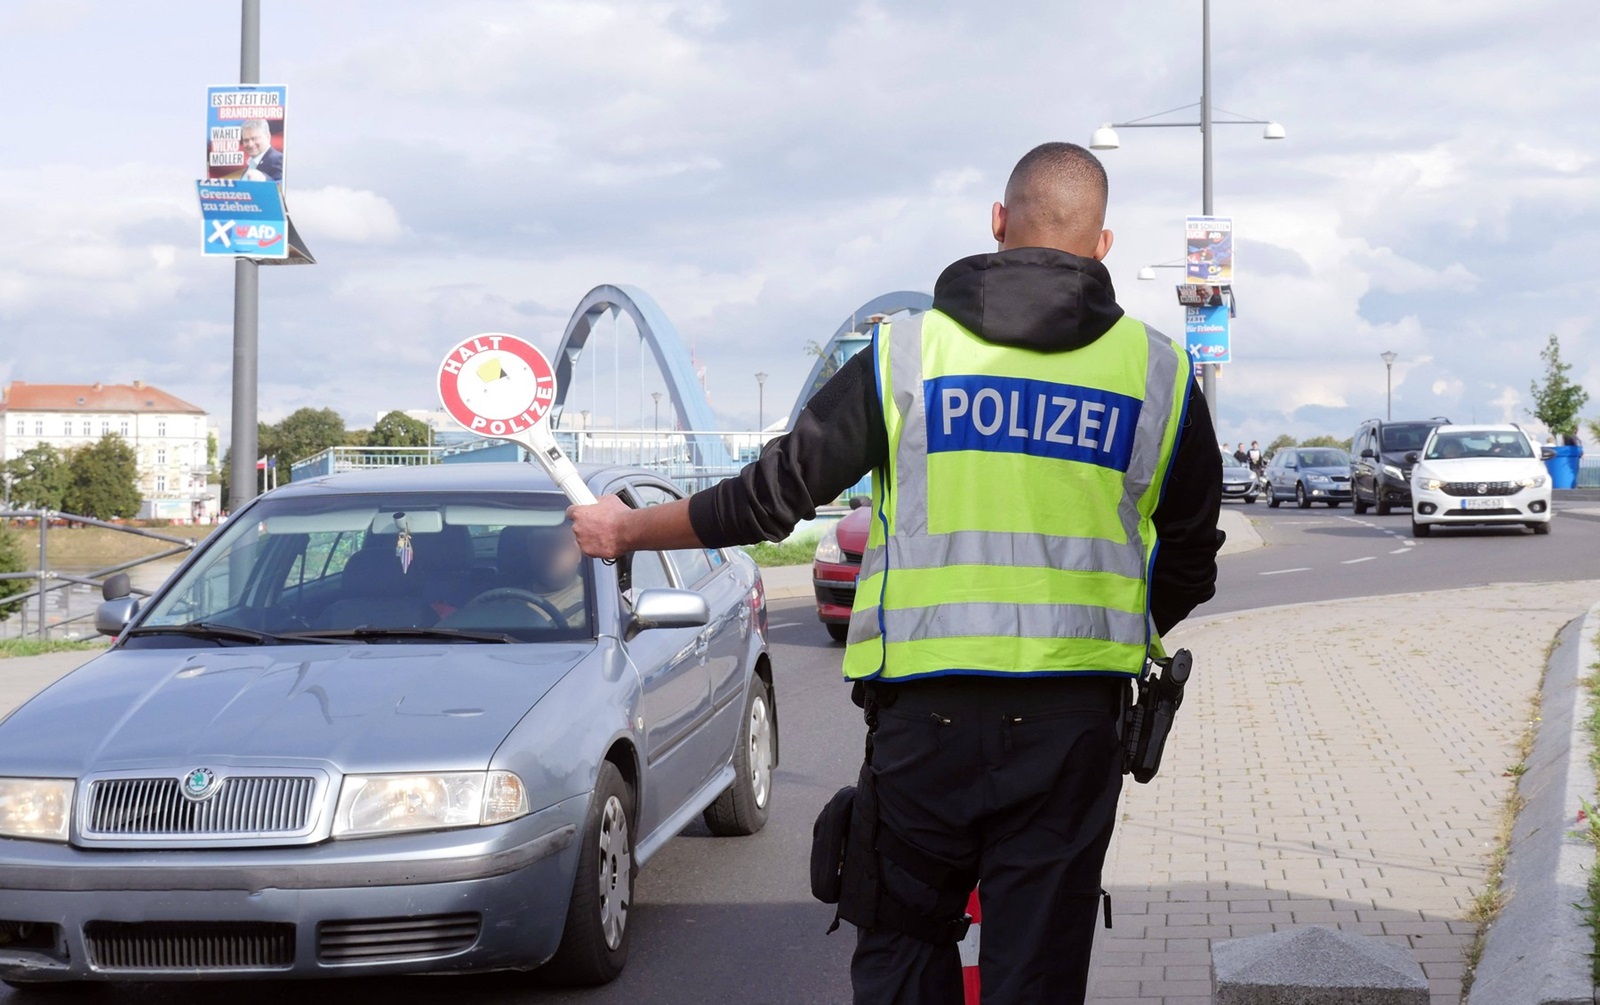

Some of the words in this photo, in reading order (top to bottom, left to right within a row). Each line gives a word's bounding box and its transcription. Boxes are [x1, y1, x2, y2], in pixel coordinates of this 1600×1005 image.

[213, 94, 222, 106] ES
[224, 94, 238, 105] IST
[240, 93, 258, 105] ZEIT
[260, 92, 278, 105] FÜR
[220, 106, 283, 119] BRANDENBURG
[212, 140, 239, 152] WILKO
[212, 152, 243, 165] MÖLLER
[200, 189, 252, 200] Grenzen
[203, 202, 219, 211] zu
[220, 201, 262, 213] ziehen.
[246, 224, 277, 239] AfD
[1188, 315, 1206, 323] ZEIT
[444, 336, 502, 375] HALT
[470, 376, 552, 435] POLIZEI
[942, 387, 1120, 453] POLIZEI
